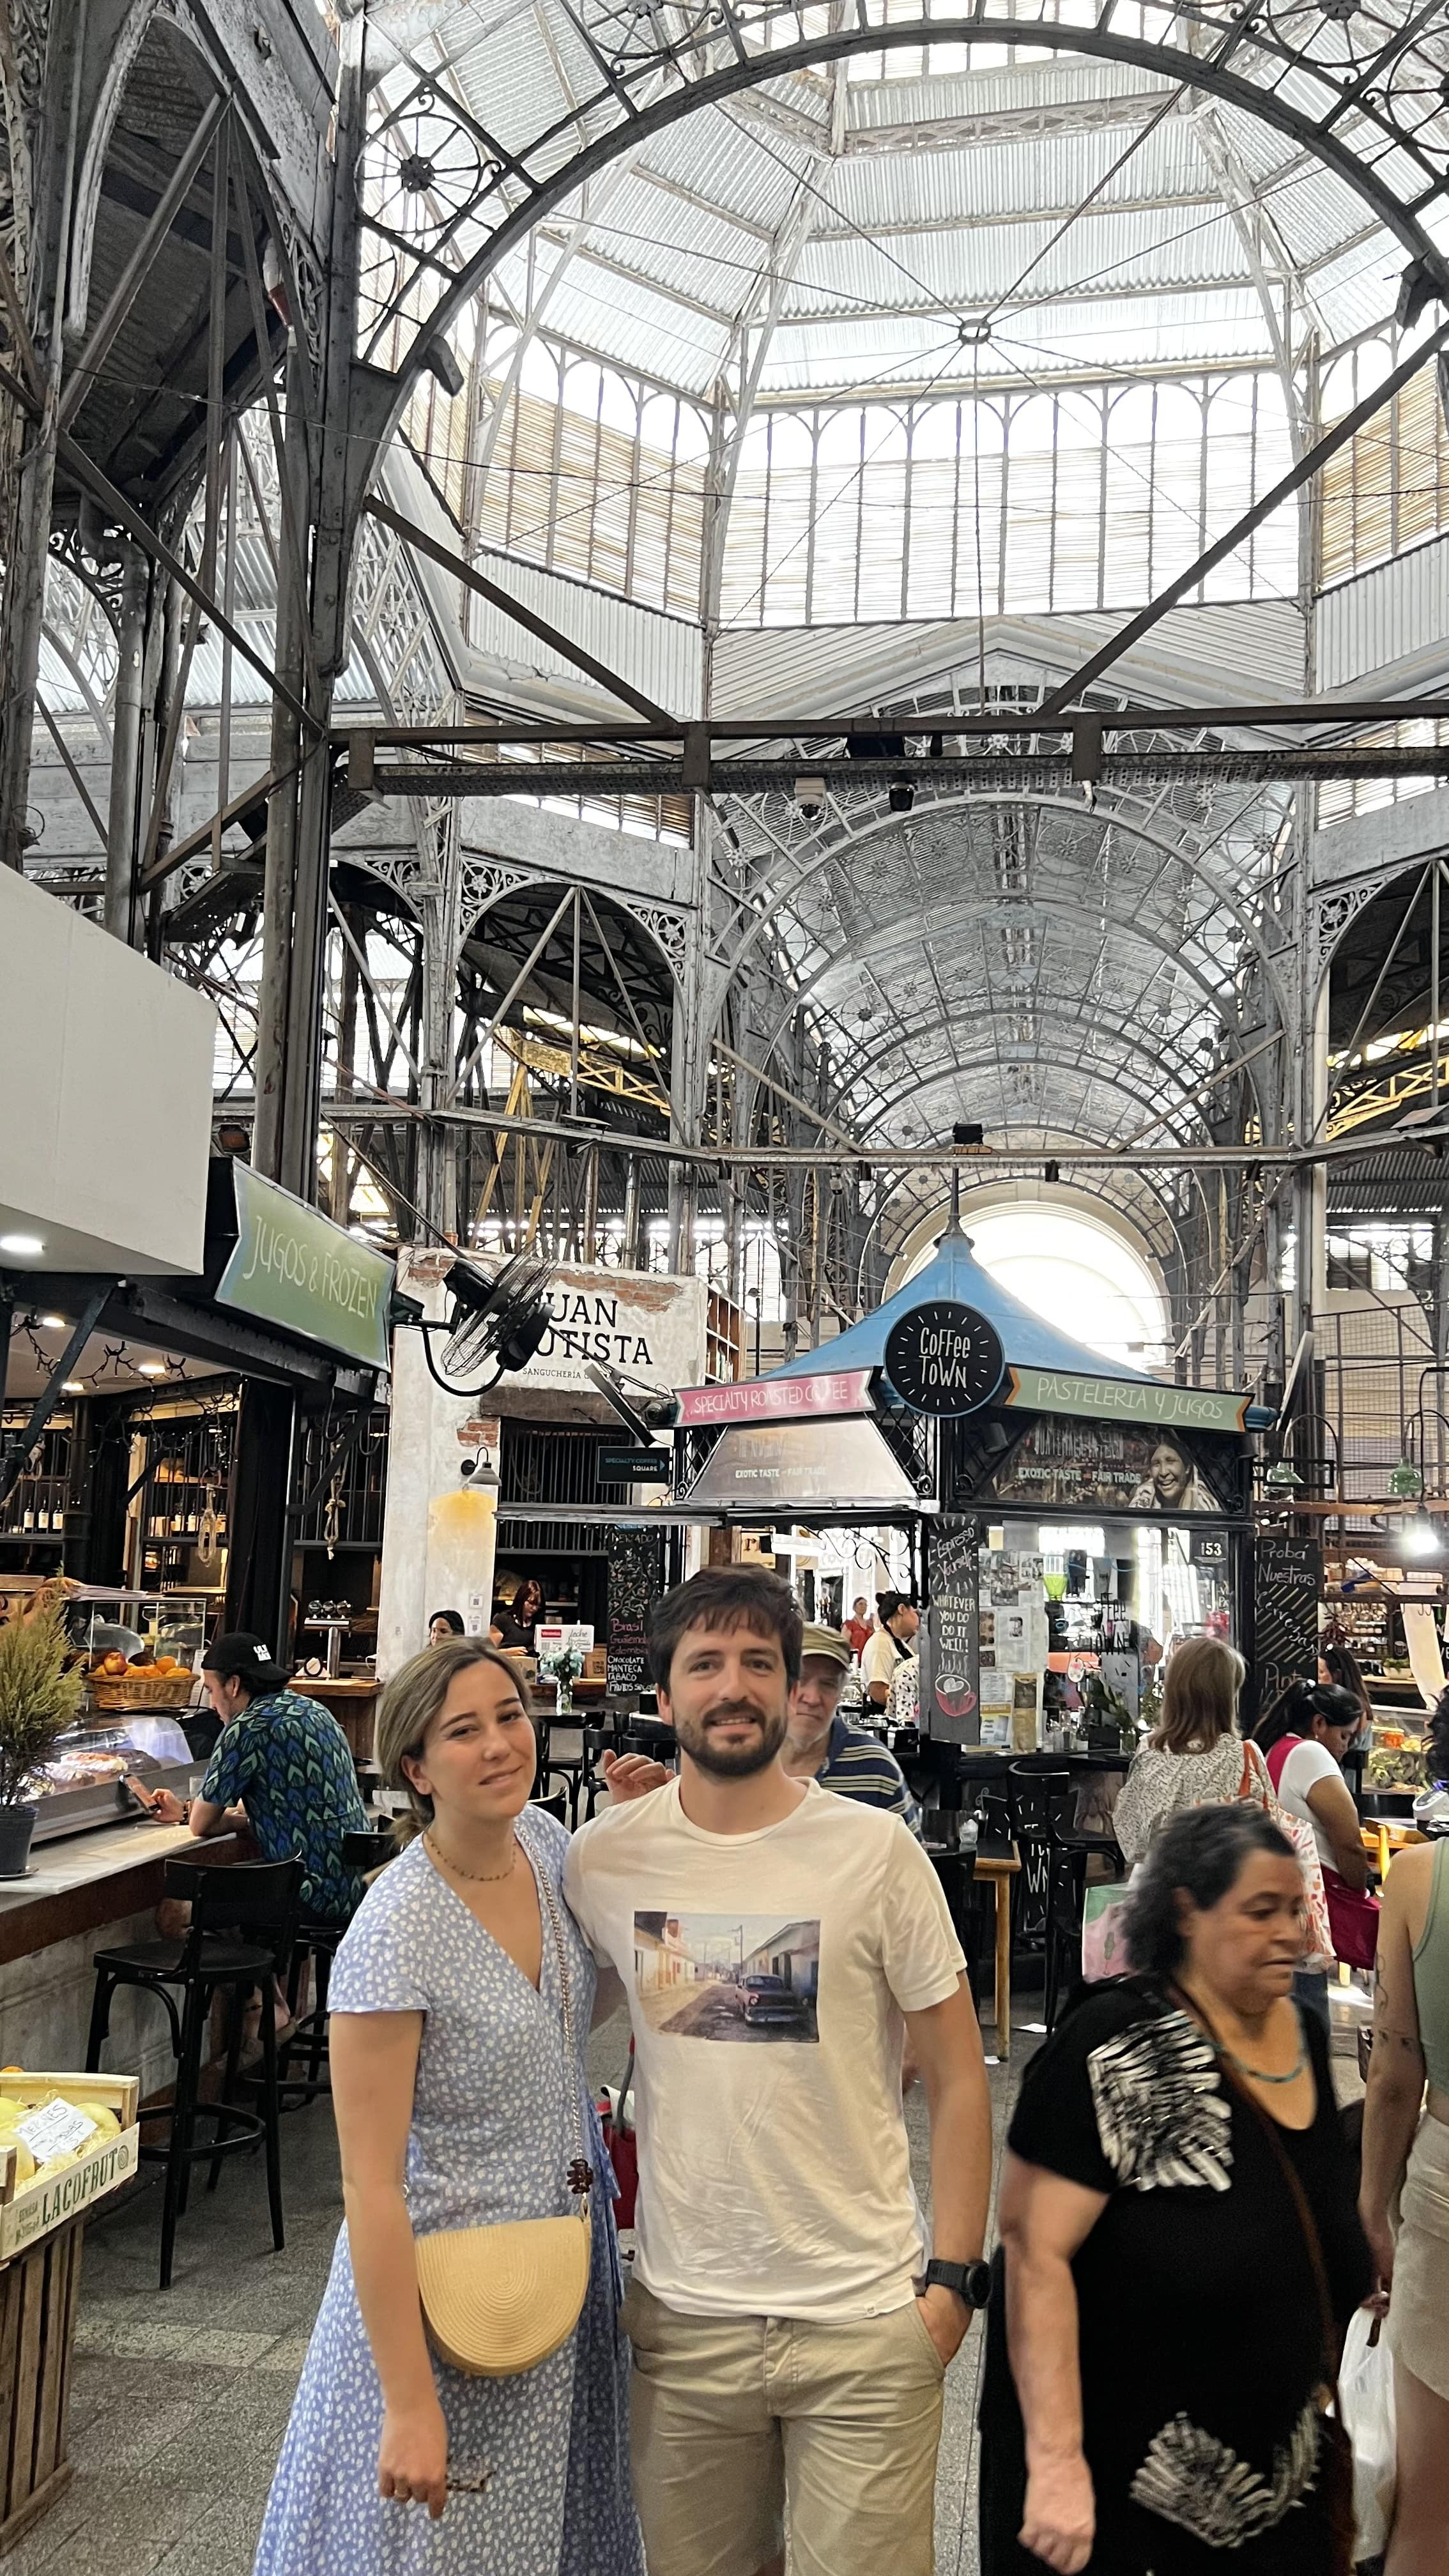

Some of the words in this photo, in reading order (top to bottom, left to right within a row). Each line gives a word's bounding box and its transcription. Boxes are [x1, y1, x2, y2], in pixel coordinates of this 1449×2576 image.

[242, 1216, 308, 1287] JUGOS
[322, 1252, 377, 1319] FROZEN
[539, 1289, 618, 1328] UAN
[535, 1326, 653, 1365] UTISTA
[694, 1390, 747, 1416] SPECIALTY
[751, 1385, 803, 1407] ROASTED
[1163, 1395, 1223, 1420] JUGOS
[736, 1469, 758, 1478] EXOTIC
[759, 1468, 780, 1477] TASTE
[1018, 1467, 1050, 1479] EXOTIC
[1053, 1469, 1082, 1481] TASTE
[1092, 1471, 1112, 1482] FAIR
[1113, 1472, 1142, 1483] TRADE
[931, 1595, 976, 1612] WHATEVER
[611, 1618, 643, 1632] Brasil
[939, 1611, 955, 1624] YOU
[957, 1612, 969, 1623] DO
[942, 1625, 954, 1636] DO
[958, 1626, 967, 1637] IT
[939, 1638, 969, 1653] WELL!
[608, 1655, 645, 1664] CHOCOLATE
[608, 1664, 643, 1673] MANTECA
[608, 1673, 637, 1681] TABACO
